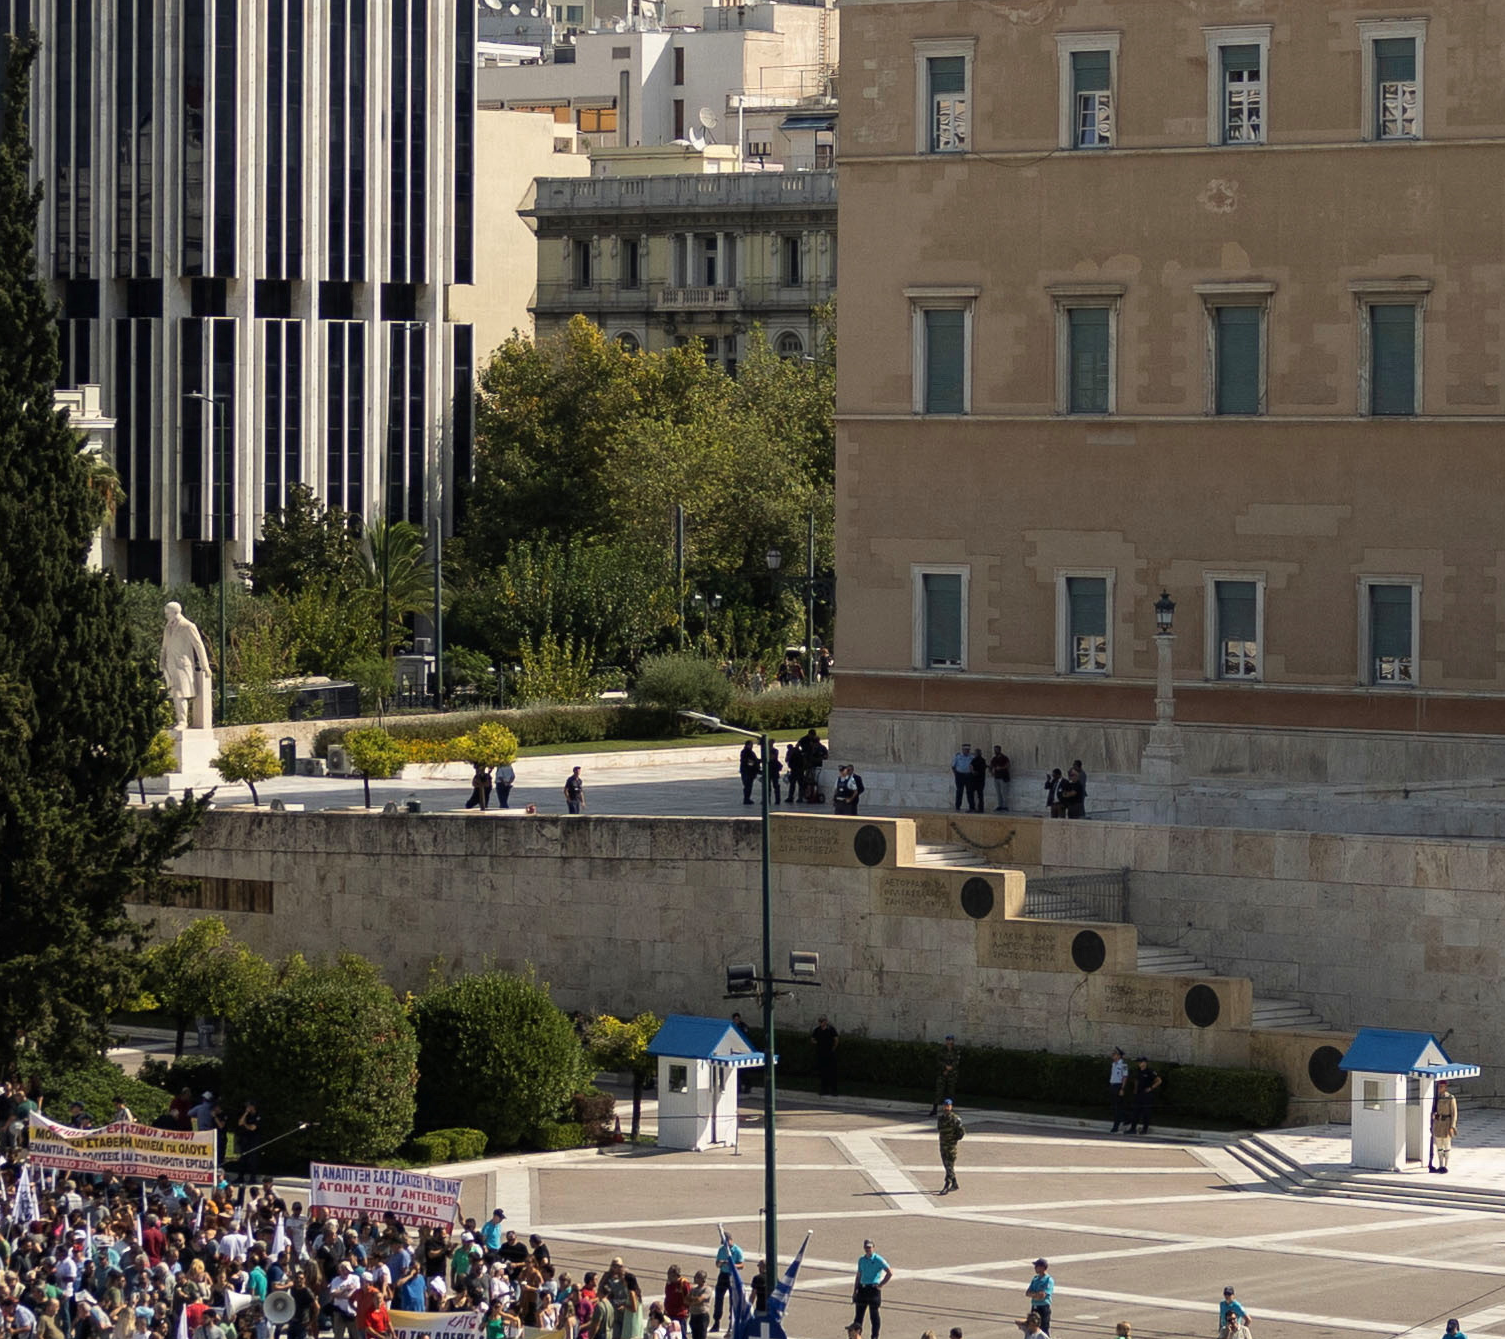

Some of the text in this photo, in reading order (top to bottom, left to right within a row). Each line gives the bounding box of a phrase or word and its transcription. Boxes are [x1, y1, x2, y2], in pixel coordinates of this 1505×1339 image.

[322, 1166, 371, 1182] ΑΝΑΠΤΥΞΗ
[373, 1169, 390, 1184] ΣΑΣ
[318, 1181, 371, 1195] ΑΓΩΝΑΣ
[375, 1185, 397, 1198] ΚΑΙ
[364, 1198, 414, 1213] ΕΠΙΛΟΓΗ
[417, 1204, 439, 1216] ΜΑΣ
